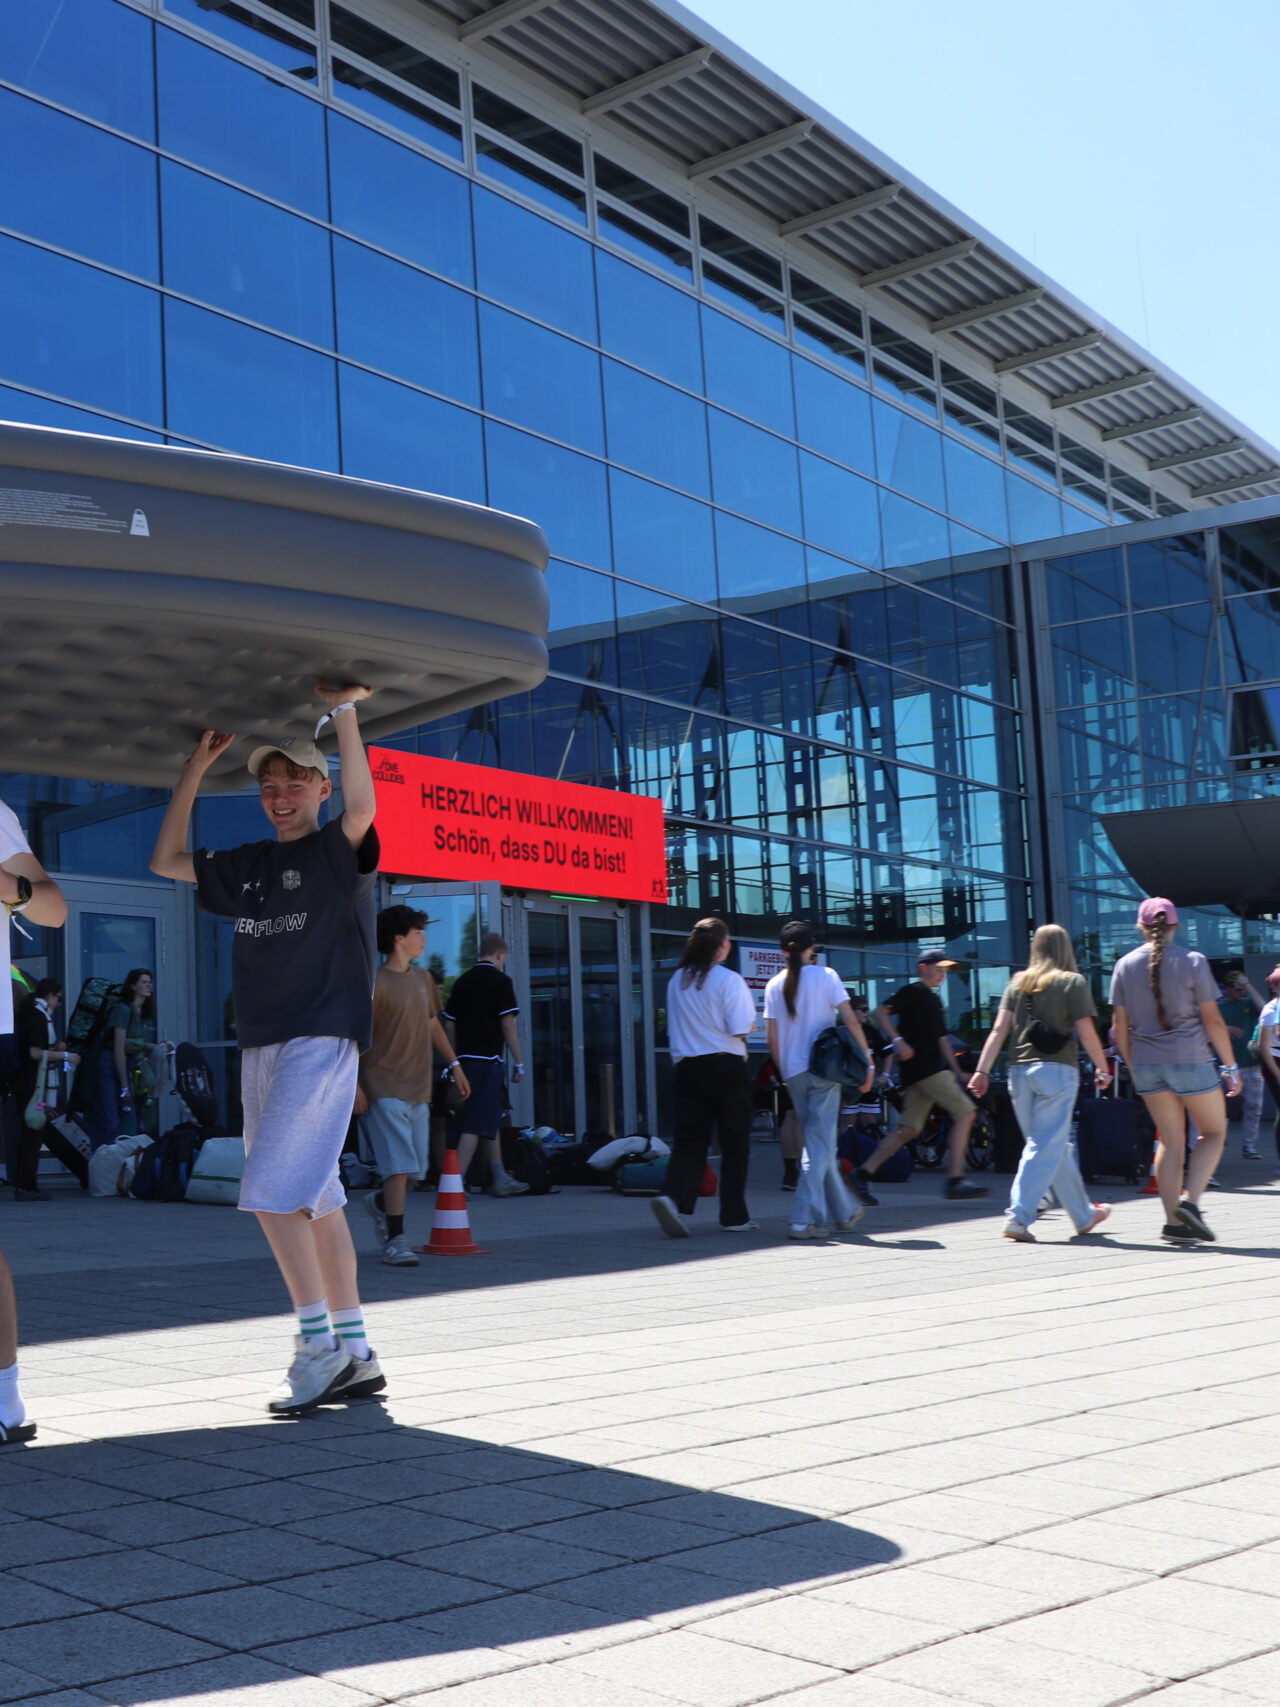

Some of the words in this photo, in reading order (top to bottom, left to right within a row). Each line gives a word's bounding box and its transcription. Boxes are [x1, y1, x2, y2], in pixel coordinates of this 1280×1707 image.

[421, 783, 512, 821] HERZLICH
[516, 798, 633, 840] WILLKOMMEN!
[434, 825, 496, 862] Schön,
[500, 835, 540, 863] dass
[544, 840, 567, 865] DU
[571, 846, 590, 869] da
[594, 848, 626, 873] bist!
